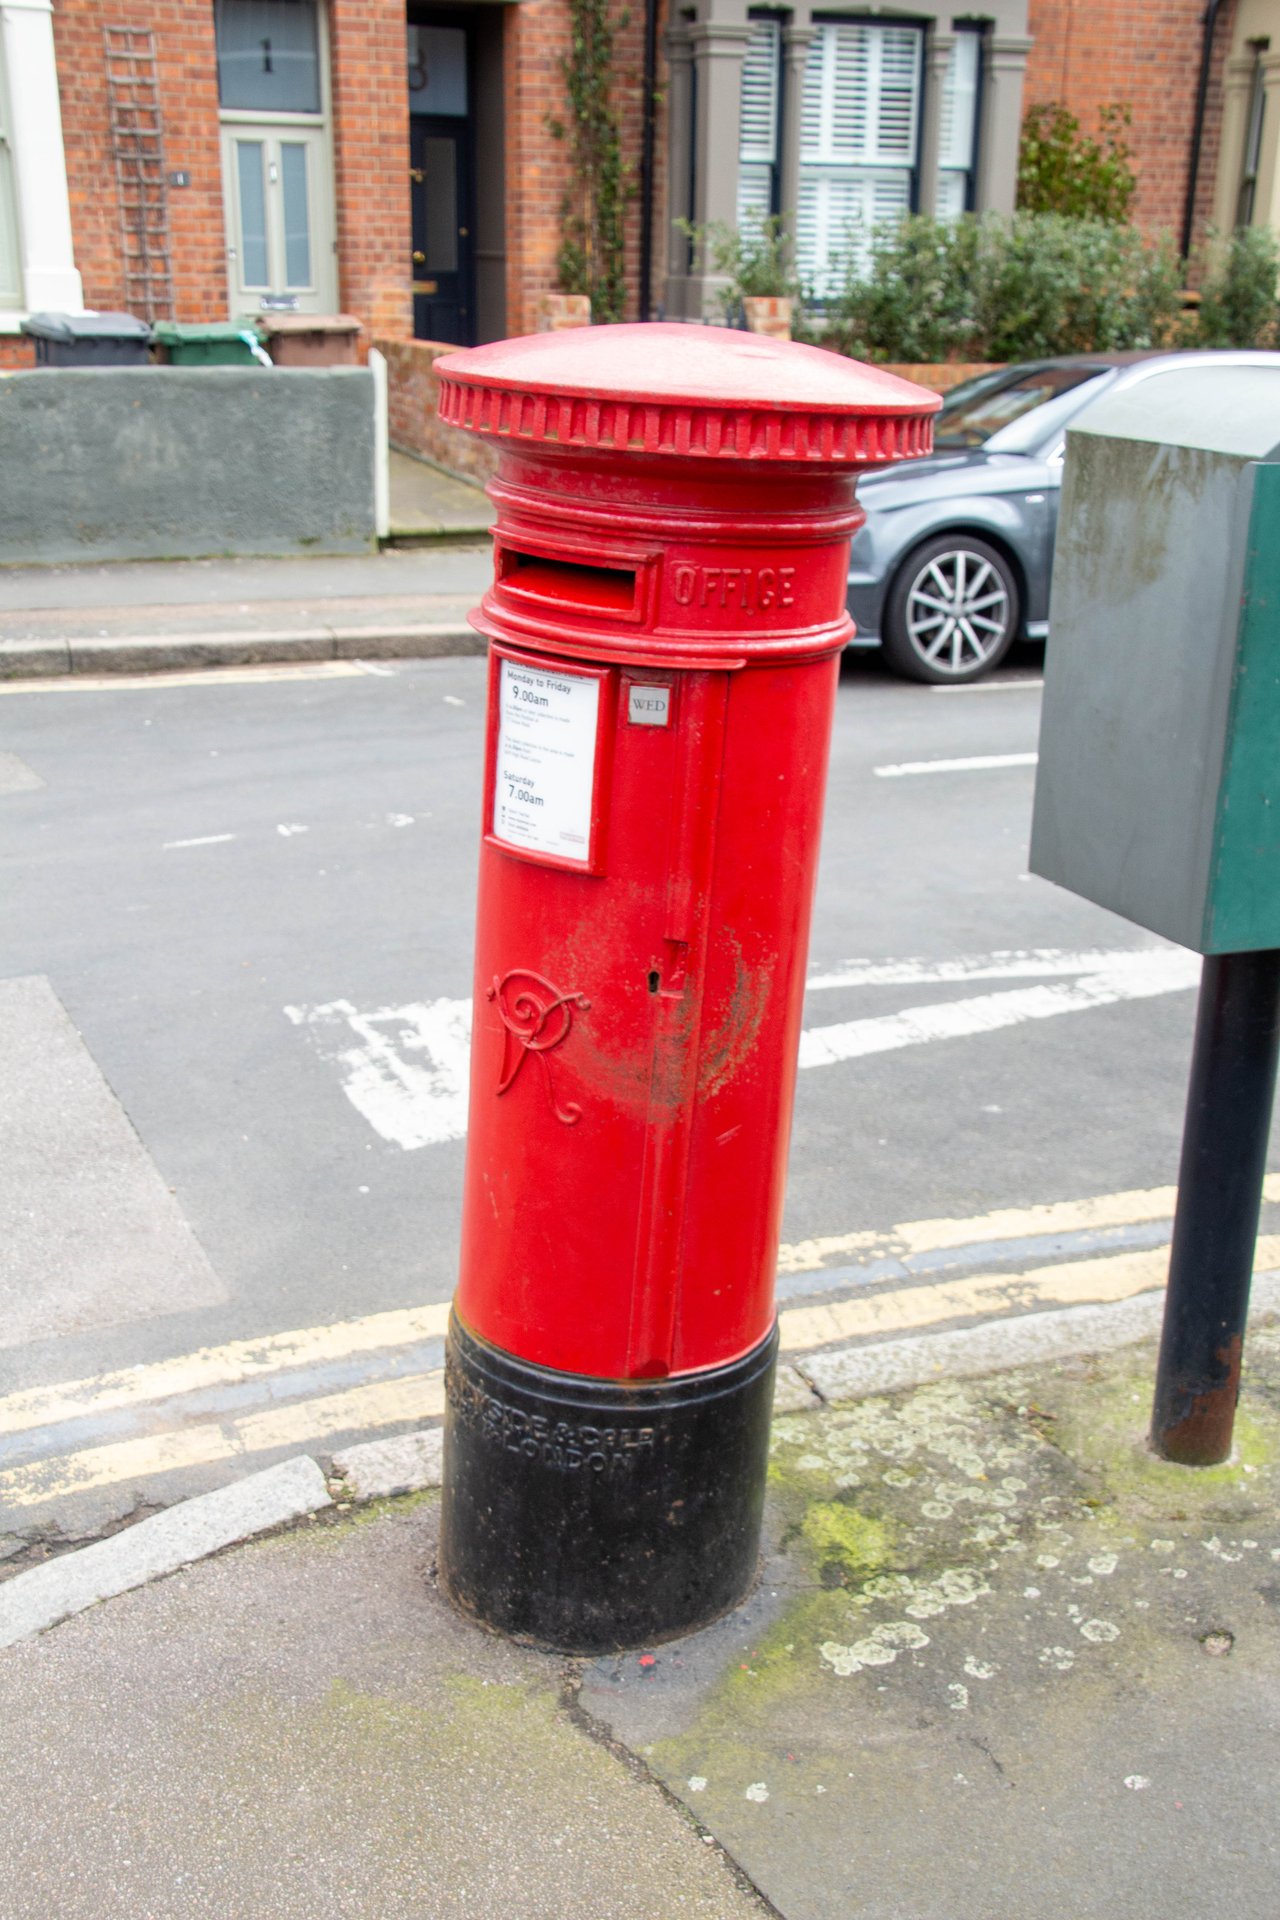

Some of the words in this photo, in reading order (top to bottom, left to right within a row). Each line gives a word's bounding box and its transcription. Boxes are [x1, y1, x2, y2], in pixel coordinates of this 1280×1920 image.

[260, 37, 274, 74] 1
[674, 566, 796, 609] OFFICE
[507, 670, 534, 687] Monday
[536, 679, 544, 688] to
[546, 680, 571, 694] Friday
[512, 685, 549, 707] 9.00am
[633, 698, 666, 712] WED
[503, 770, 535, 788] Saturday
[508, 784, 544, 806] 7.00am
